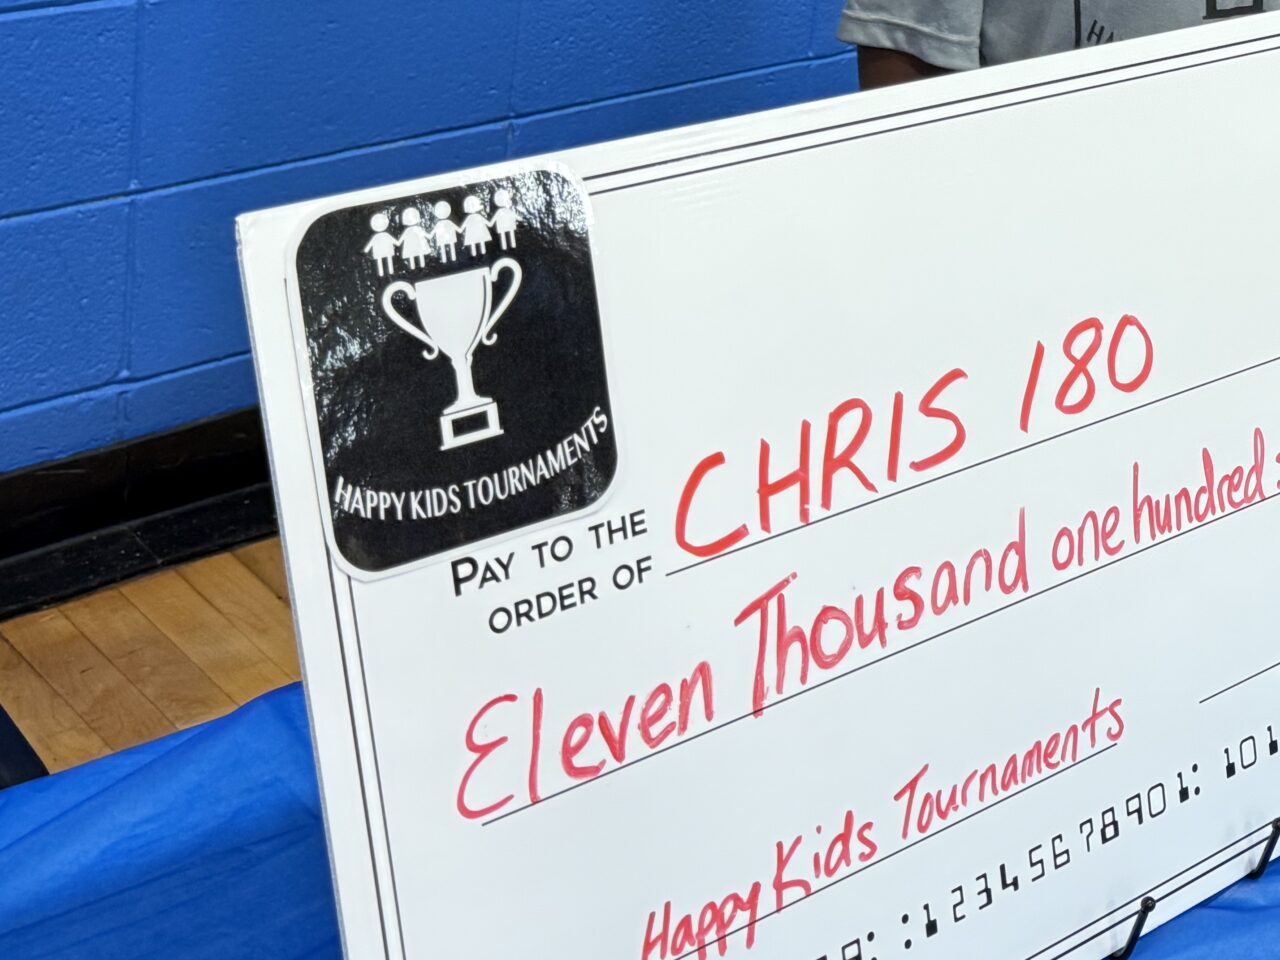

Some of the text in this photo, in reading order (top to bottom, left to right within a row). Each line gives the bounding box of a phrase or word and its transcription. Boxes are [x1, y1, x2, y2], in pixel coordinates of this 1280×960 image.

[334, 406, 608, 521] HAPPY KIDS TOURNAMENTS
[675, 314, 1154, 557] CHRIS 180
[488, 555, 652, 634] ORDER OF
[531, 535, 574, 569] TO
[588, 509, 648, 549] THE
[456, 660, 715, 820] Eleven
[734, 506, 1029, 719] Thousand
[1052, 505, 1125, 572] one
[1132, 427, 1266, 544] hundred
[1223, 725, 1279, 779] 101
[641, 687, 1124, 960] Happy Kids Tournaments
